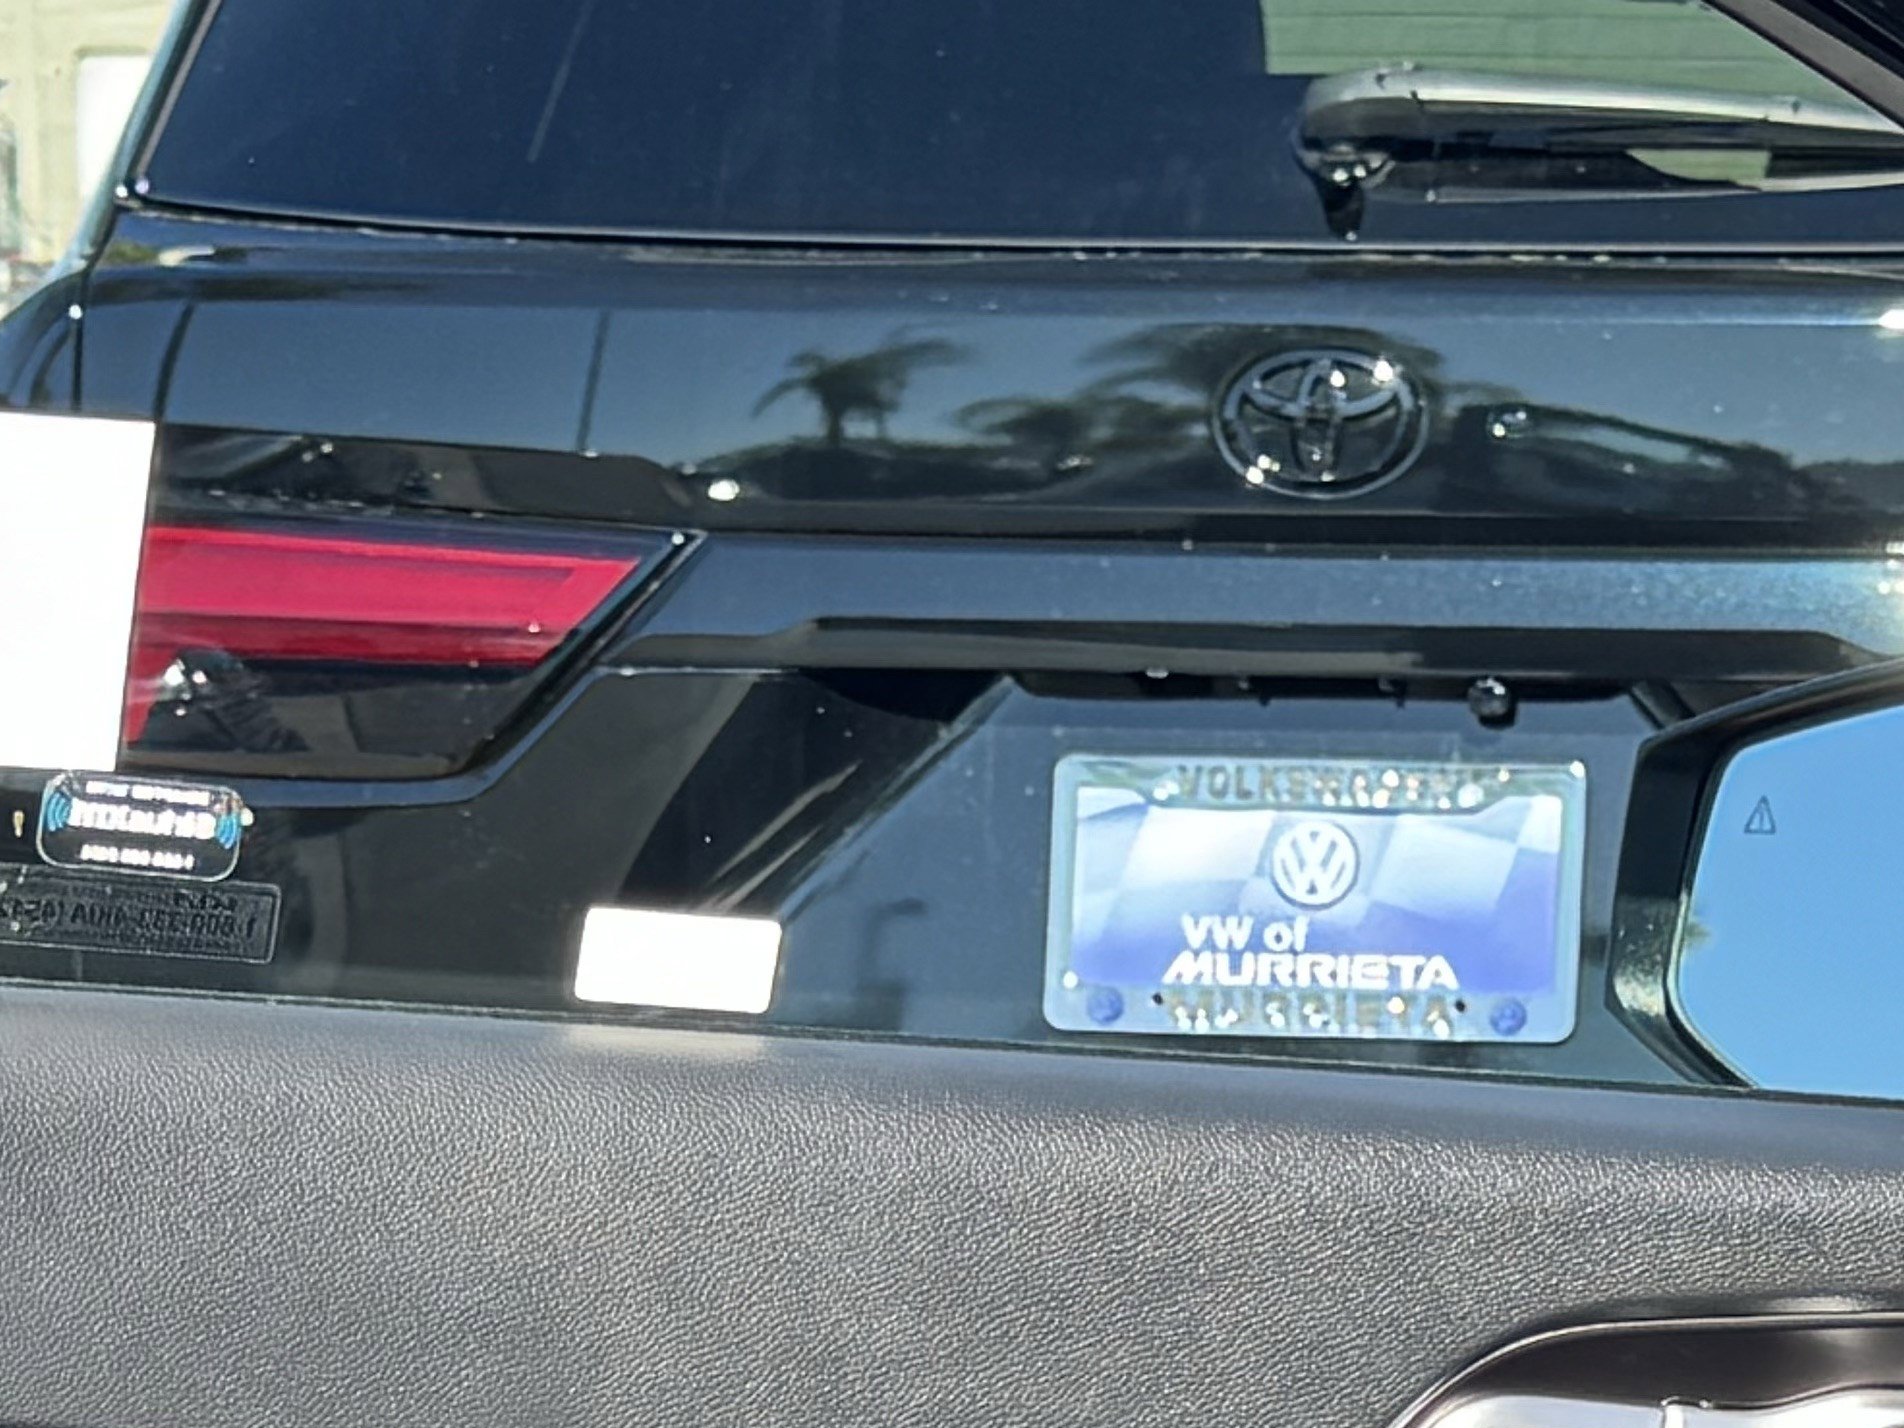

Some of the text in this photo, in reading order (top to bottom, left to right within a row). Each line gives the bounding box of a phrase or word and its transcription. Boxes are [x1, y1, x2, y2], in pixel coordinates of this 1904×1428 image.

[1180, 914, 1309, 951] VW of
[1161, 950, 1460, 990] MURRIETA
